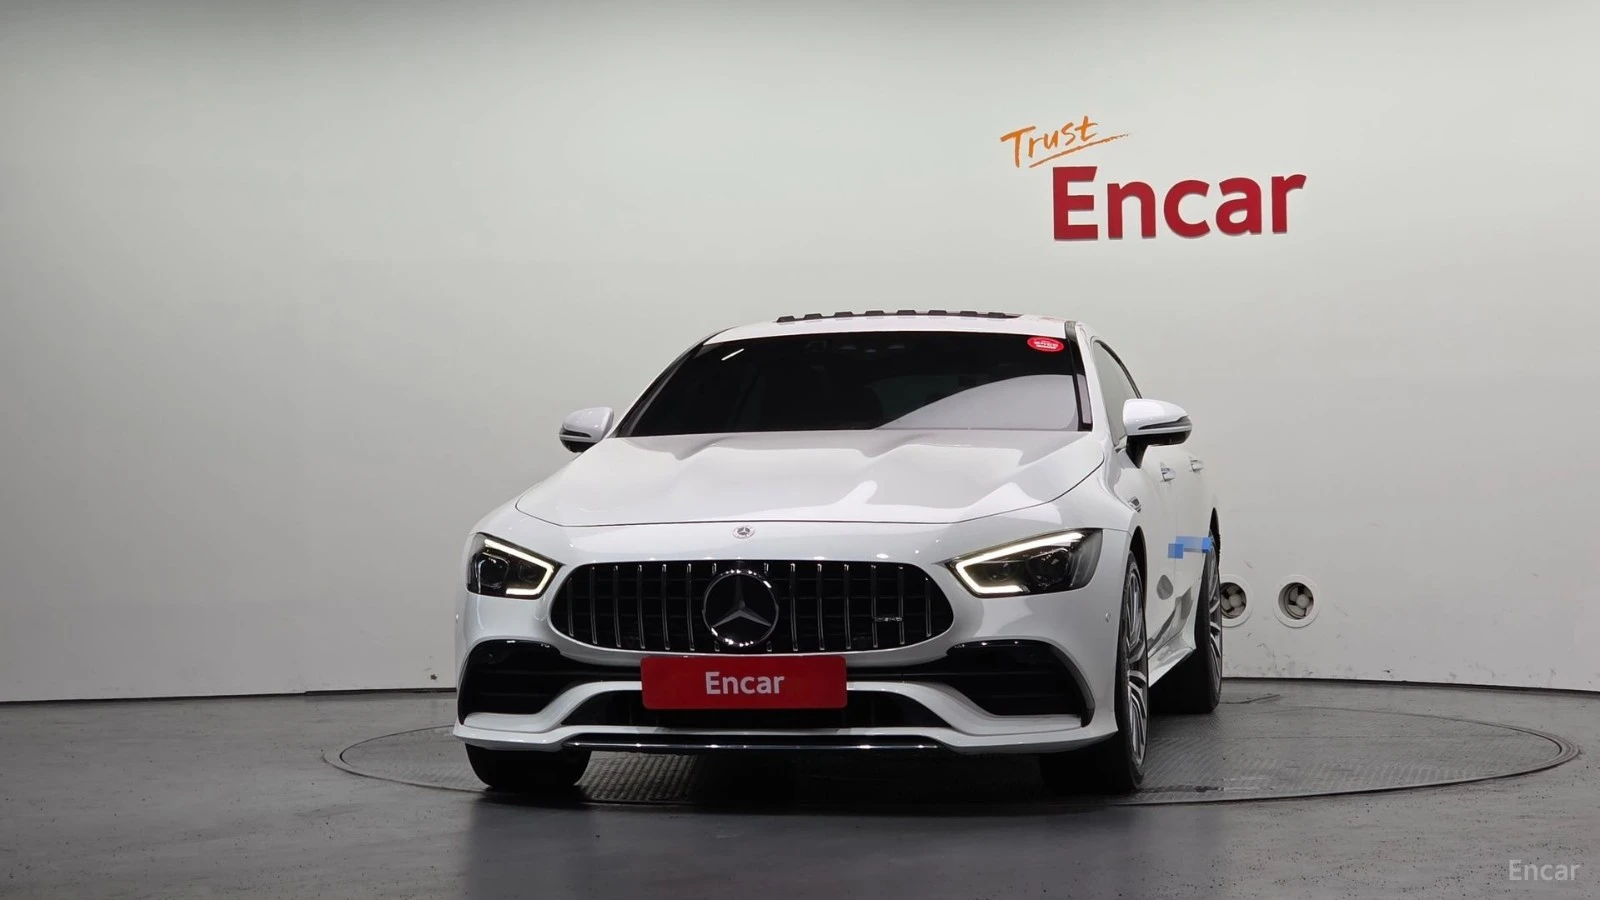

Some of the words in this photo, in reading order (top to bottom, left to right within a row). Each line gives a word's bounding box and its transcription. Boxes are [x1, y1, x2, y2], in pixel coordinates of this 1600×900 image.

[1000, 115, 1100, 168] Trust
[1053, 166, 1307, 241] Encar
[705, 671, 785, 695] Encar
